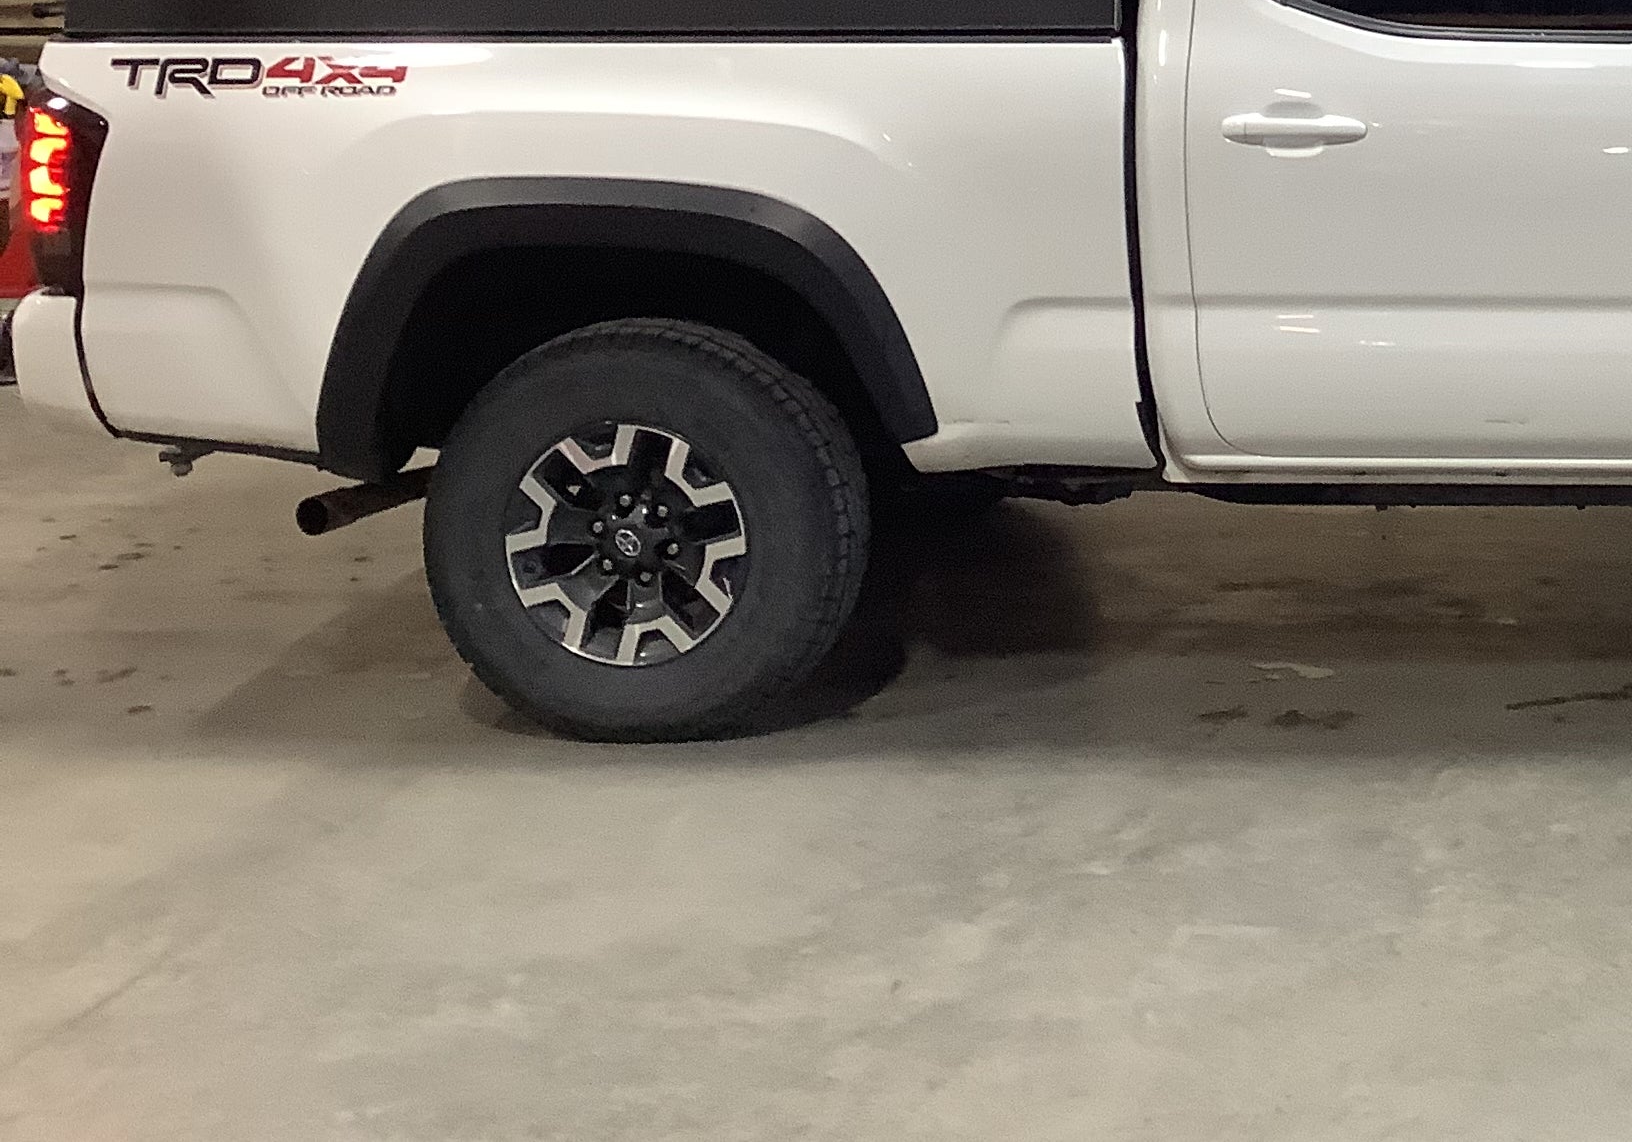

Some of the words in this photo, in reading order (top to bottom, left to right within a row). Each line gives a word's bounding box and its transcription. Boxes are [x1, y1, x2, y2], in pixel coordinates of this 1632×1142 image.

[111, 57, 265, 98] TRD
[262, 85, 317, 98] OFF
[320, 85, 397, 98] ROAD
